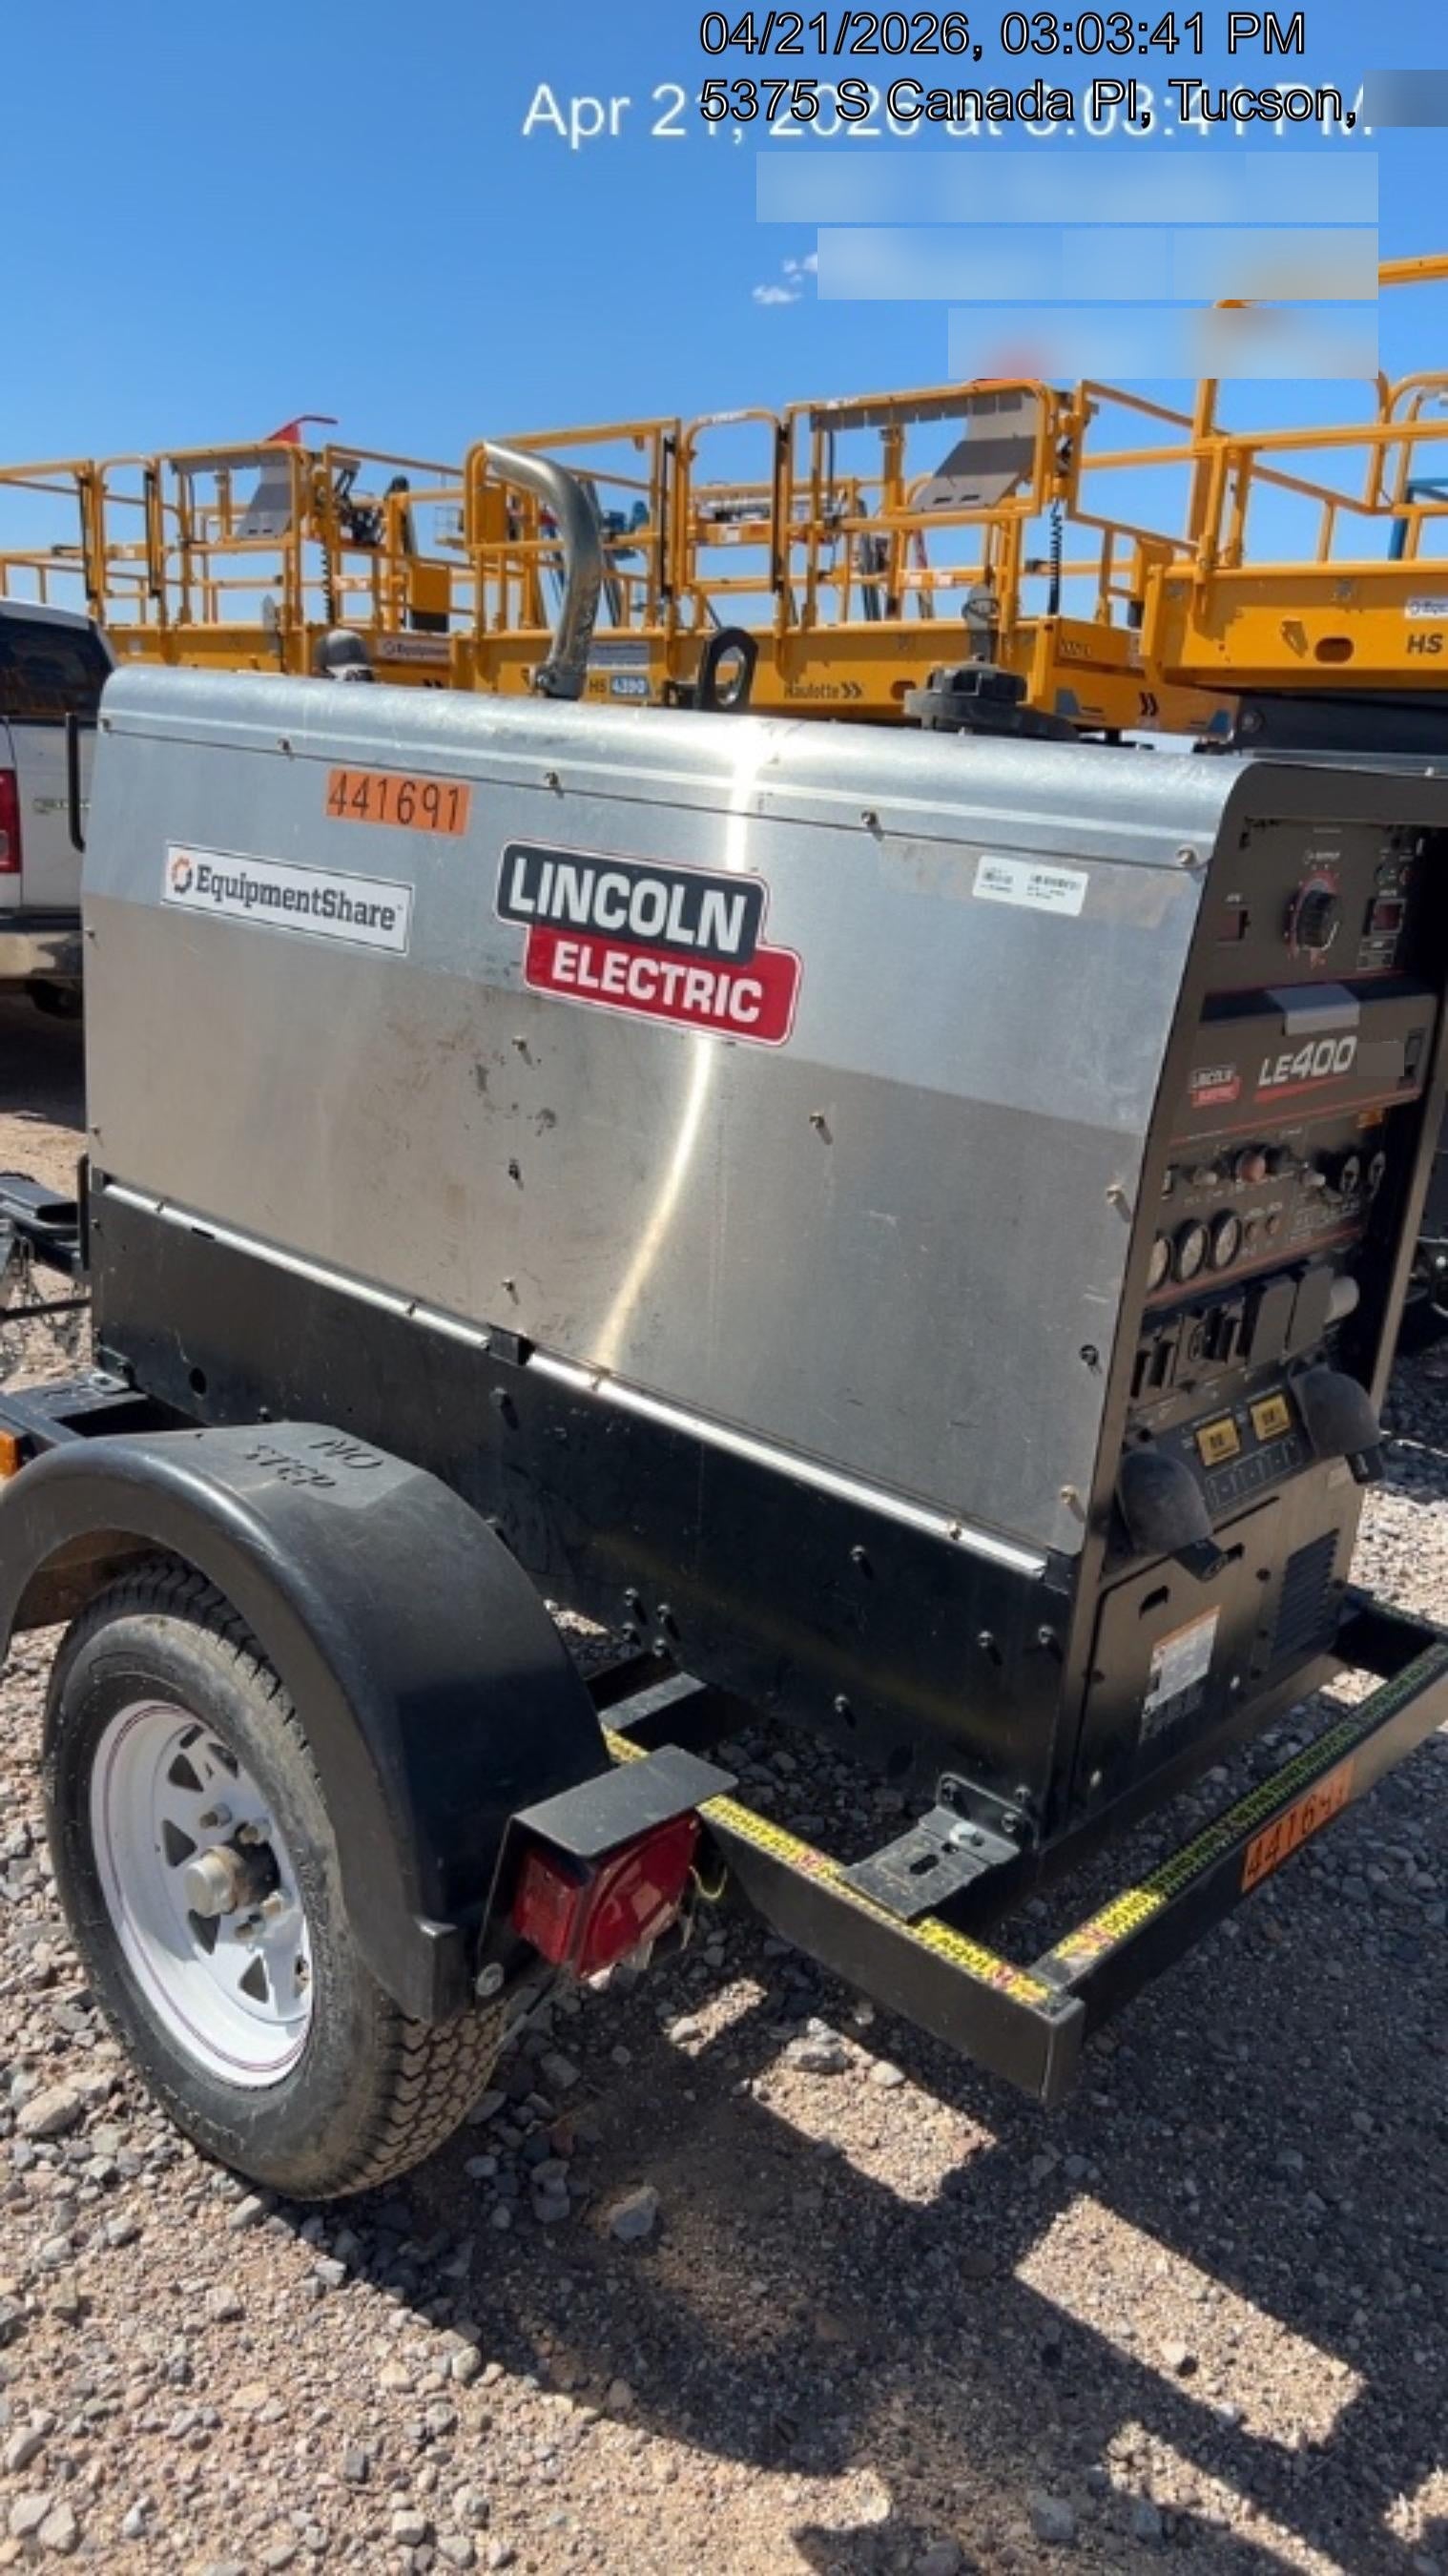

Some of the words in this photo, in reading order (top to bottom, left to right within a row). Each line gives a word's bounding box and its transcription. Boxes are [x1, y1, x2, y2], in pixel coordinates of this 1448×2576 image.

[1406, 633, 1443, 654] HS
[327, 771, 460, 833] 441691
[197, 863, 397, 931] EquipmentShare
[507, 856, 749, 954] LINCOLN
[550, 940, 764, 1024] ELECTRIC
[1257, 1034, 1358, 1086] LE400
